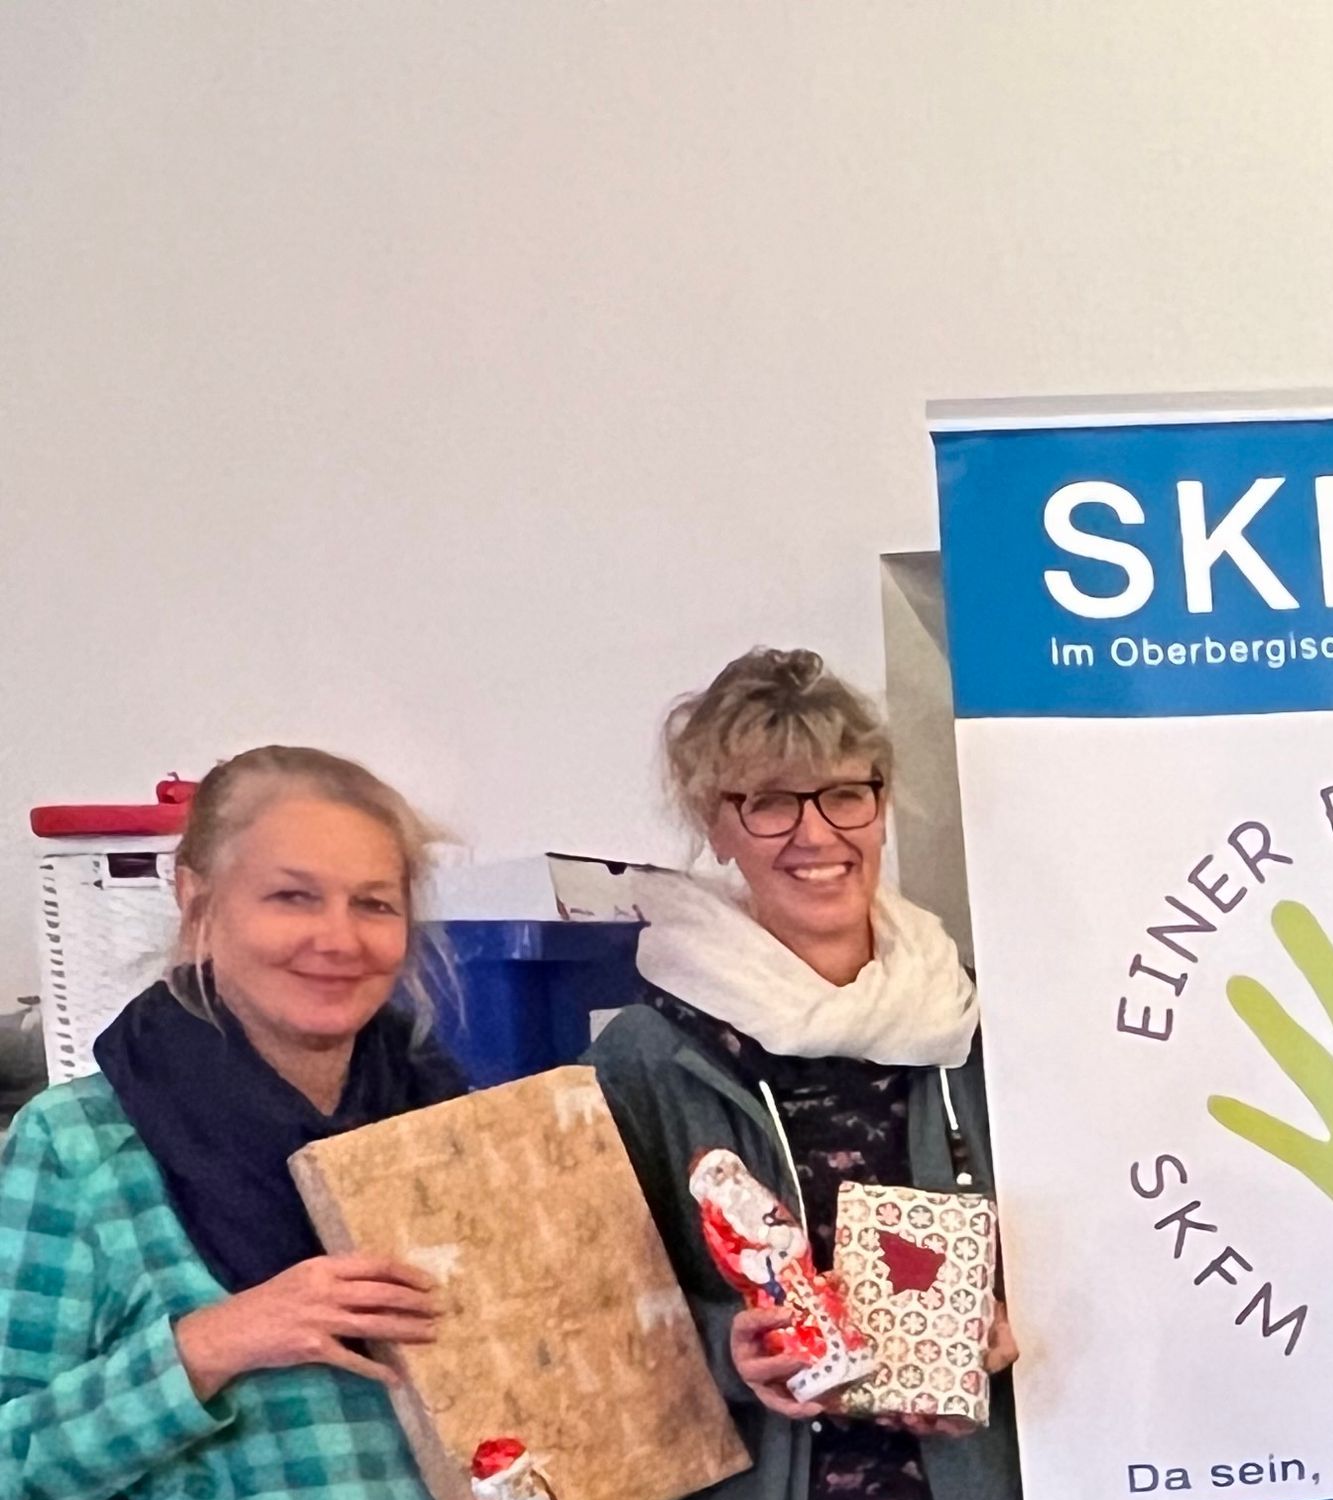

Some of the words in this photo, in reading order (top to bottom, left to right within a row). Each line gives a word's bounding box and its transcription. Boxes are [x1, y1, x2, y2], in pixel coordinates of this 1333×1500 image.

[1116, 820, 1293, 1041] EINER
[1130, 1153, 1310, 1356] SKFM
[1127, 1463, 1192, 1494] Da
[1210, 1453, 1322, 1487] sein,
